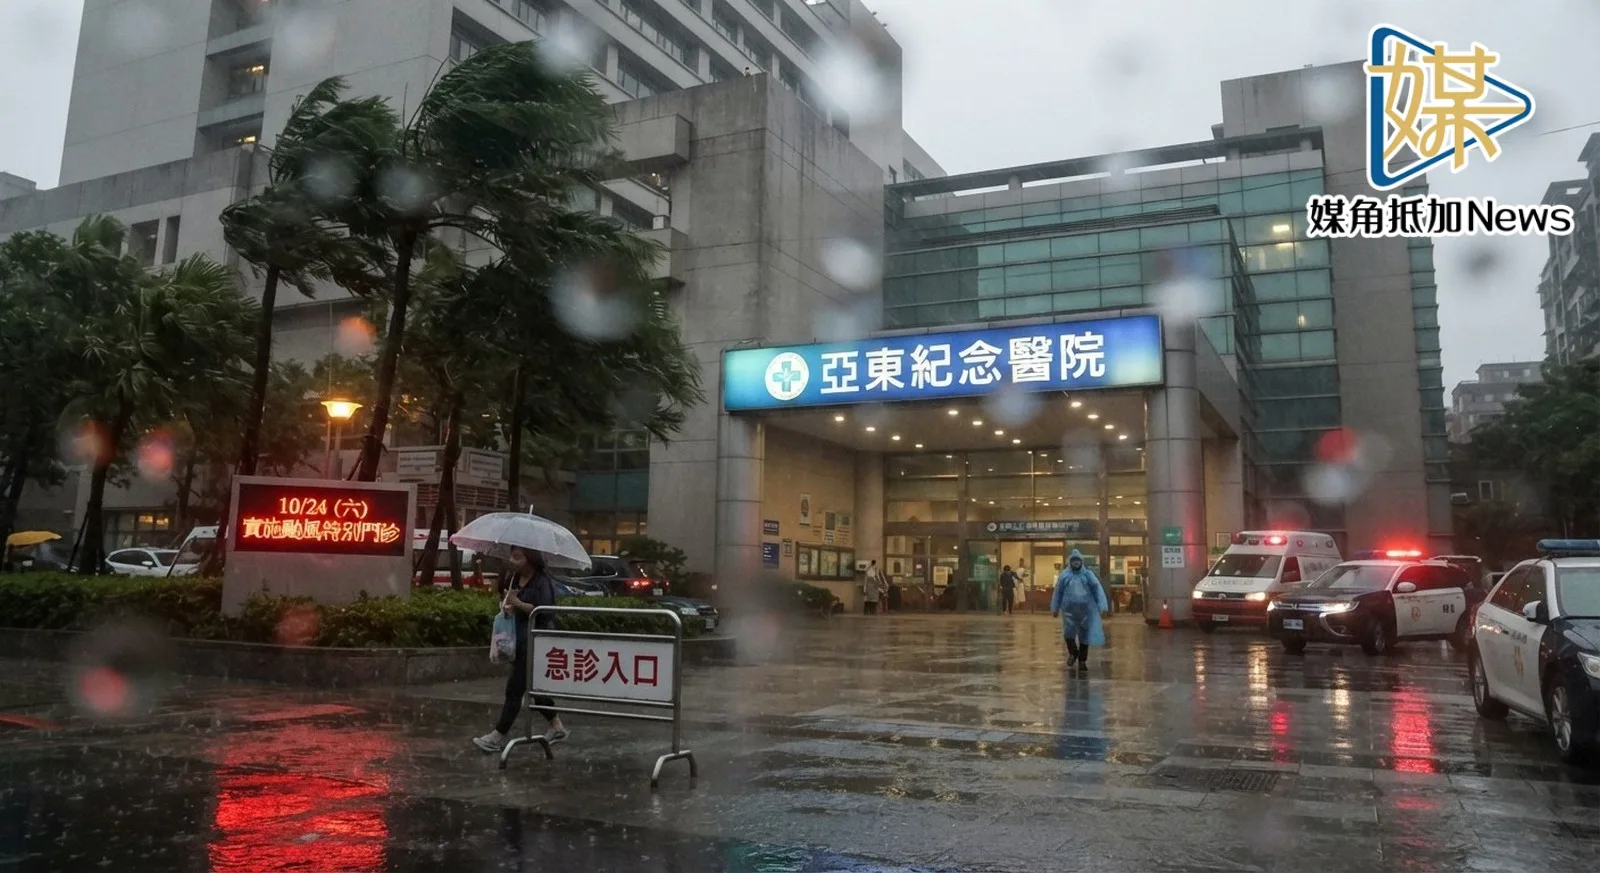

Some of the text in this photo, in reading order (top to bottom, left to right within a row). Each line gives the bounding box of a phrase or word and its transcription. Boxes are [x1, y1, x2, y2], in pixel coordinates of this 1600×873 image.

[819, 331, 1107, 396] 亞東紀念醫院
[279, 497, 328, 516] 10/24
[544, 646, 659, 688] 急診入口
